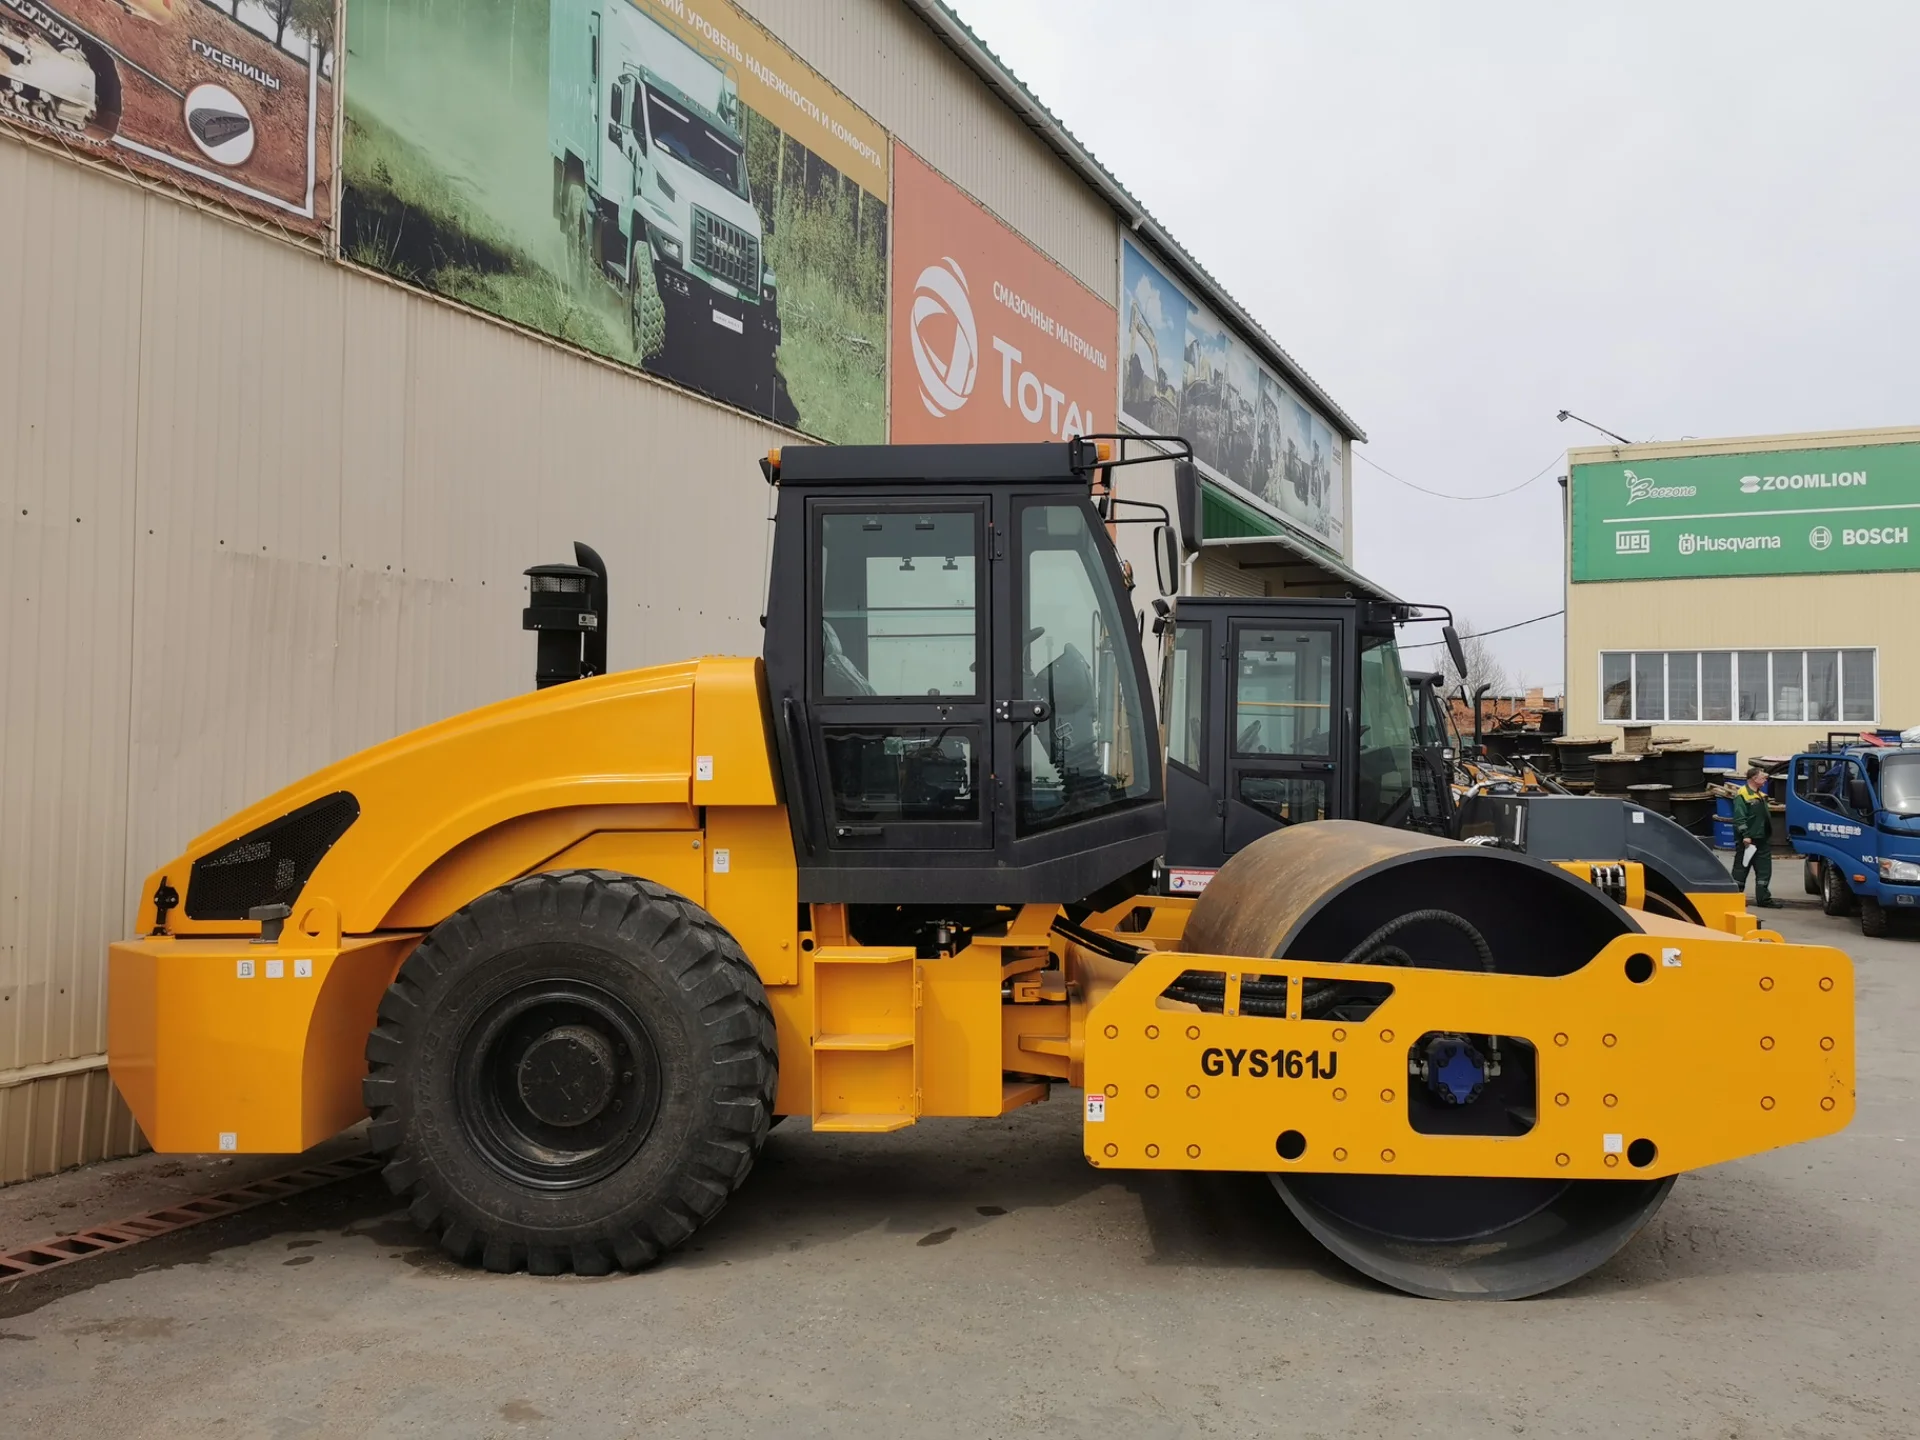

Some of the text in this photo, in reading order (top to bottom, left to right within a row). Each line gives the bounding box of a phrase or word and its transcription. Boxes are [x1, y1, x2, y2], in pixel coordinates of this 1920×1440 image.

[192, 39, 280, 90] ГУСЕНИЦЫ
[687, 8, 743, 62] УРОВЕНЬ
[745, 52, 820, 122] НАДЕЖНОСТИ
[821, 111, 829, 130] И
[831, 119, 882, 169] КОМФОРТА
[993, 280, 1054, 337] СМАЗОЧНЫЕ
[1056, 322, 1107, 371] МАТЕРИАЛЫ
[1632, 477, 1697, 501] Beezone
[1763, 471, 1867, 491] ZOOMLION
[1697, 534, 1781, 553] Husqvarna
[1842, 527, 1908, 546] BOSCH
[1187, 879, 1208, 887] TOTA
[1201, 1048, 1337, 1080] GYS161J
